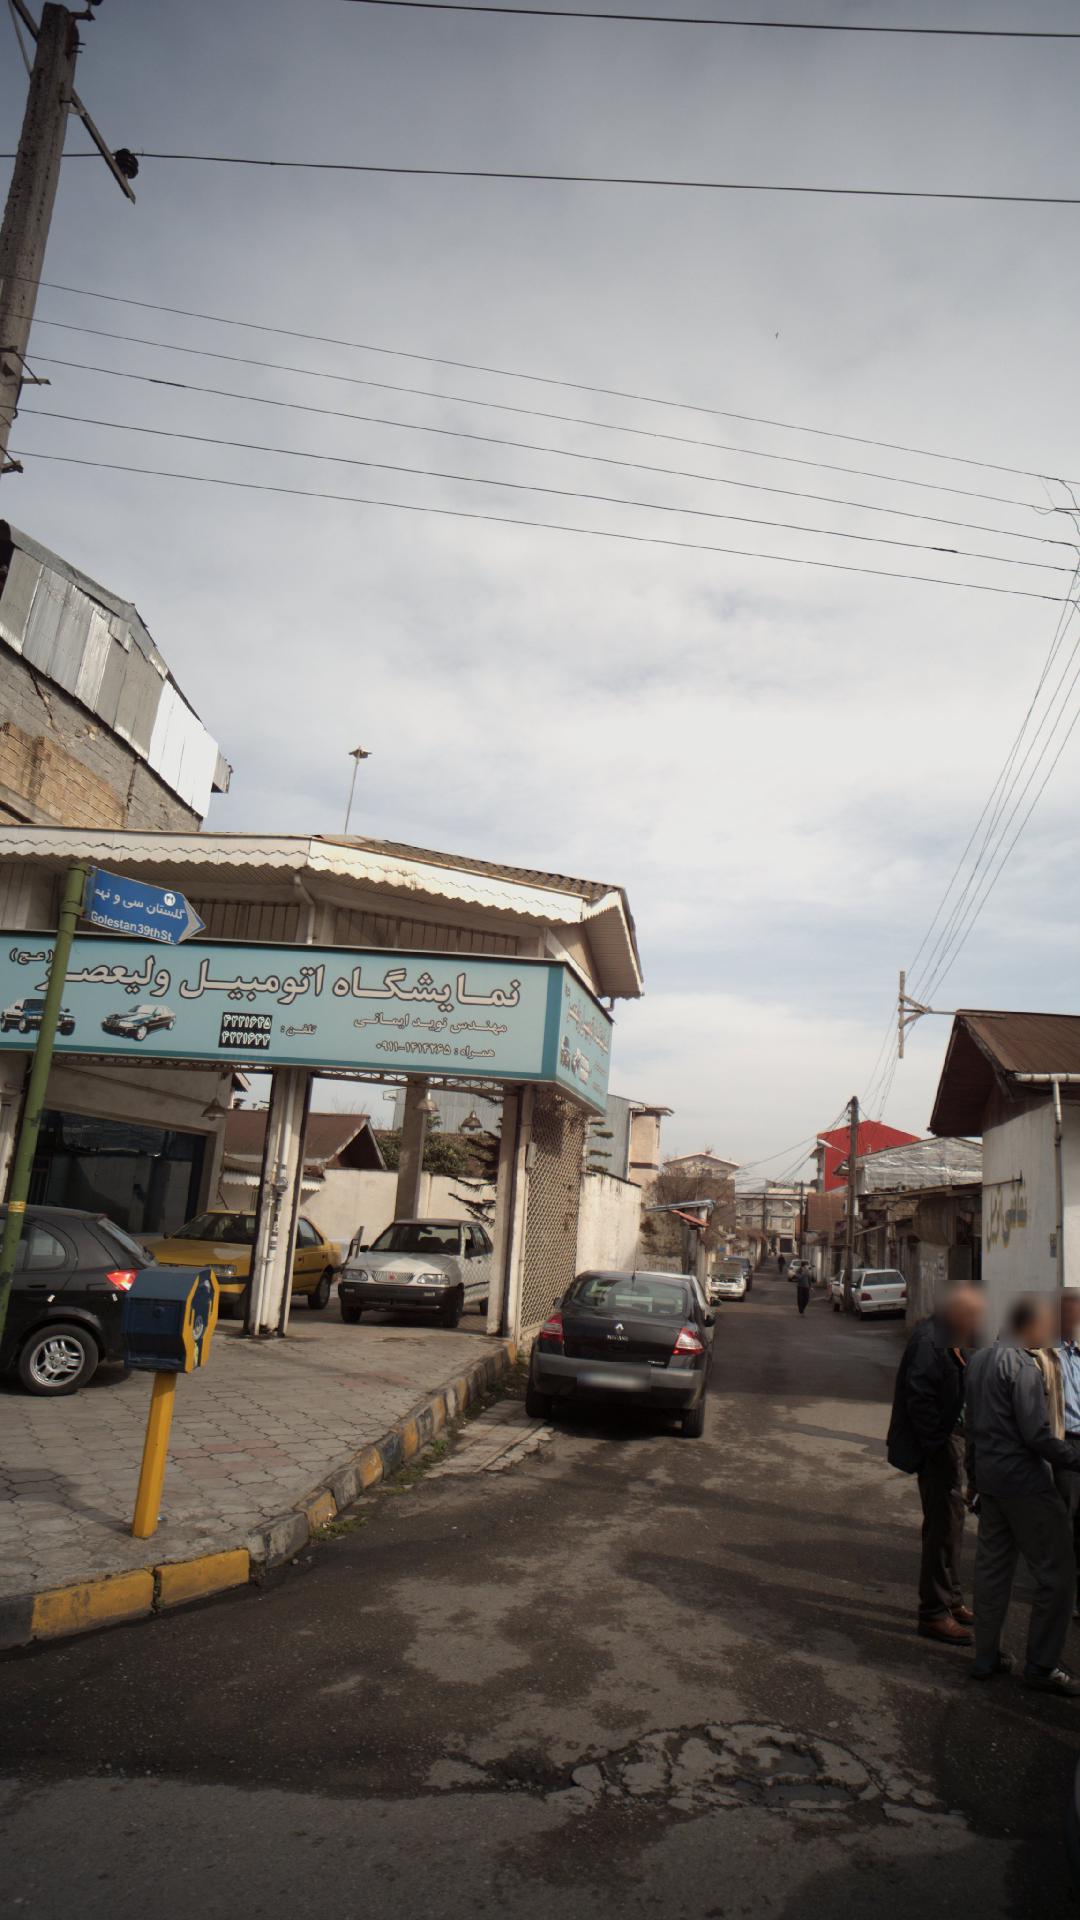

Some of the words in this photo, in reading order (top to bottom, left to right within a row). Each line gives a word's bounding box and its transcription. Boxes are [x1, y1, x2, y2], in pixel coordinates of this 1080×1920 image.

[94, 888, 111, 901] نهم
[113, 894, 121, 905] و
[123, 900, 144, 909] سی
[146, 904, 186, 920] گلستان
[91, 911, 137, 933] Golestan
[137, 923, 160, 939] 39th
[160, 929, 175, 943] St.
[179, 958, 326, 1005] اتومبیل
[332, 966, 521, 1012] نمایشگاه
[353, 1011, 410, 1030] ایمانی
[411, 1016, 448, 1032] نوید
[450, 1020, 508, 1035] مهندس
